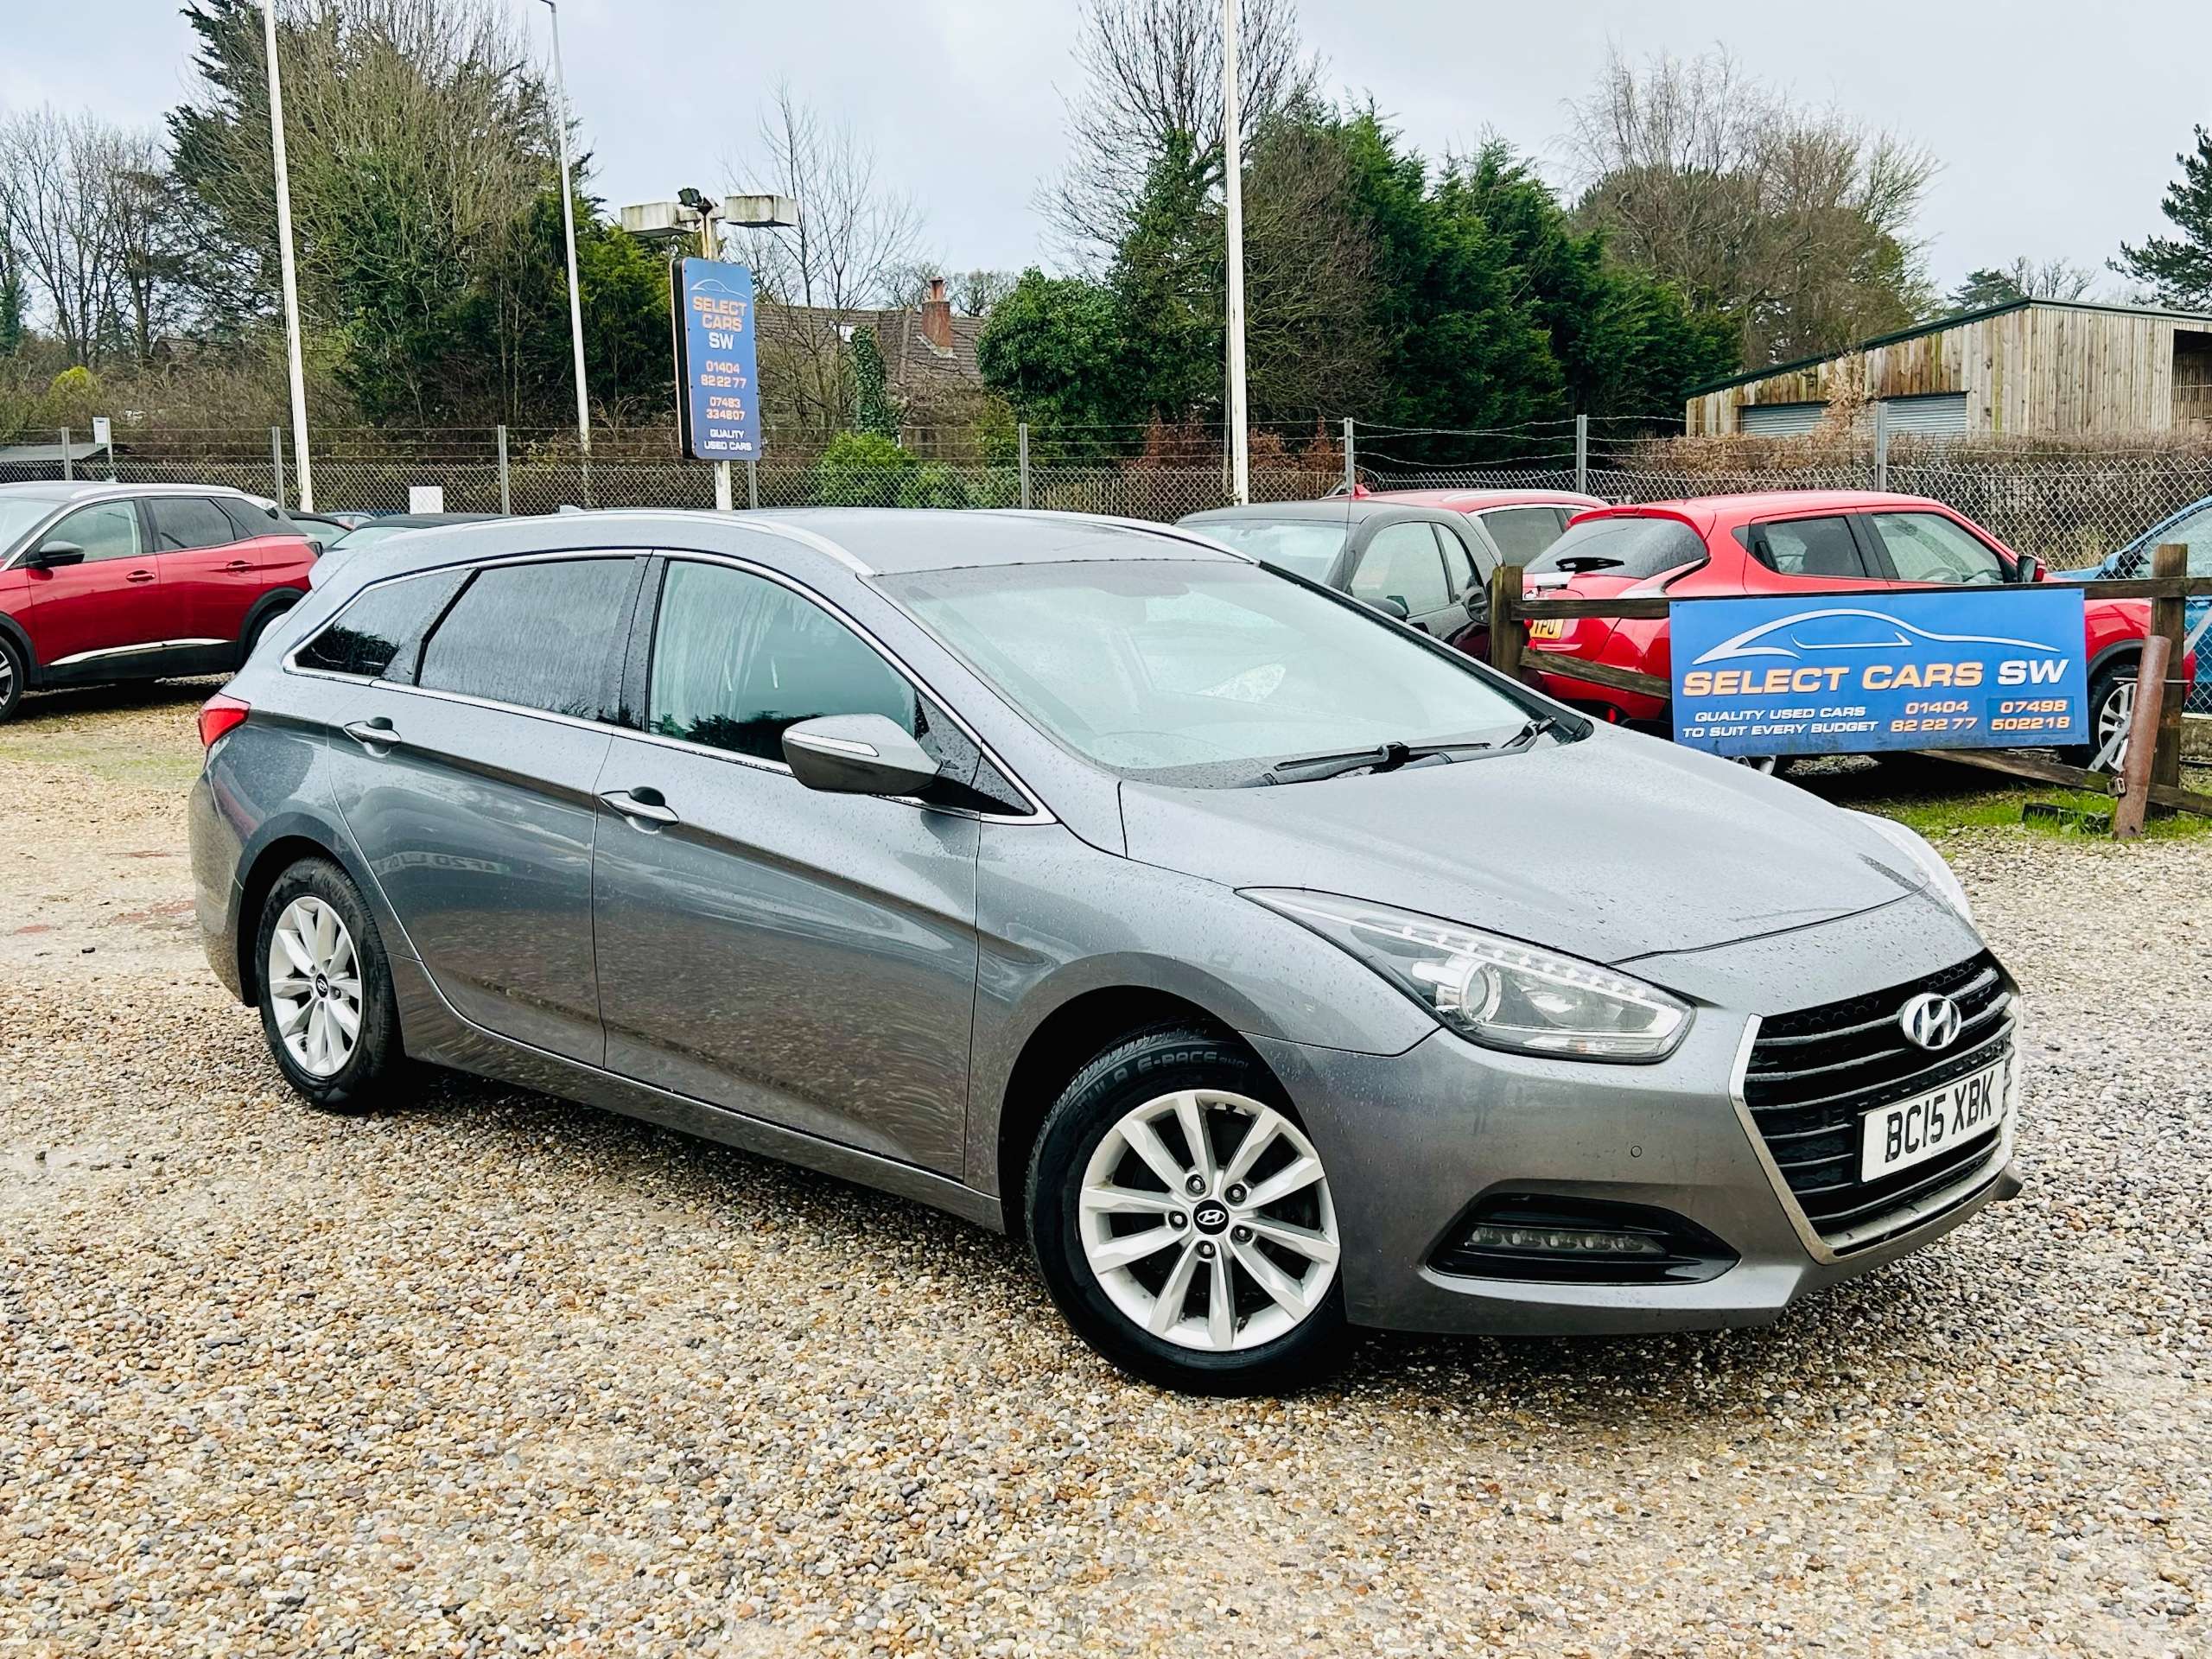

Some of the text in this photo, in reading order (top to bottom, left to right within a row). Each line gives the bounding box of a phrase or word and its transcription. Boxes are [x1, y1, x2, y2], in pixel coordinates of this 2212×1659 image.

[693, 296, 747, 317] SELECT
[702, 313, 743, 332] CARS
[709, 332, 734, 350] SW
[706, 359, 741, 374] 01404
[710, 429, 744, 439] QUALITY
[703, 440, 753, 452] USED CARS
[1682, 659, 2069, 696] SELECT CARS SW
[1694, 706, 1866, 723] QUALITY USED CARS
[1904, 700, 1970, 715] 01404
[1999, 699, 2068, 715] 07498
[1682, 720, 1879, 738] TO SUIT EVERY BUDGET
[1890, 716, 1979, 733] 82 22 77
[1990, 715, 2071, 731] 502218
[1885, 1070, 1994, 1163] BC15 XBK
